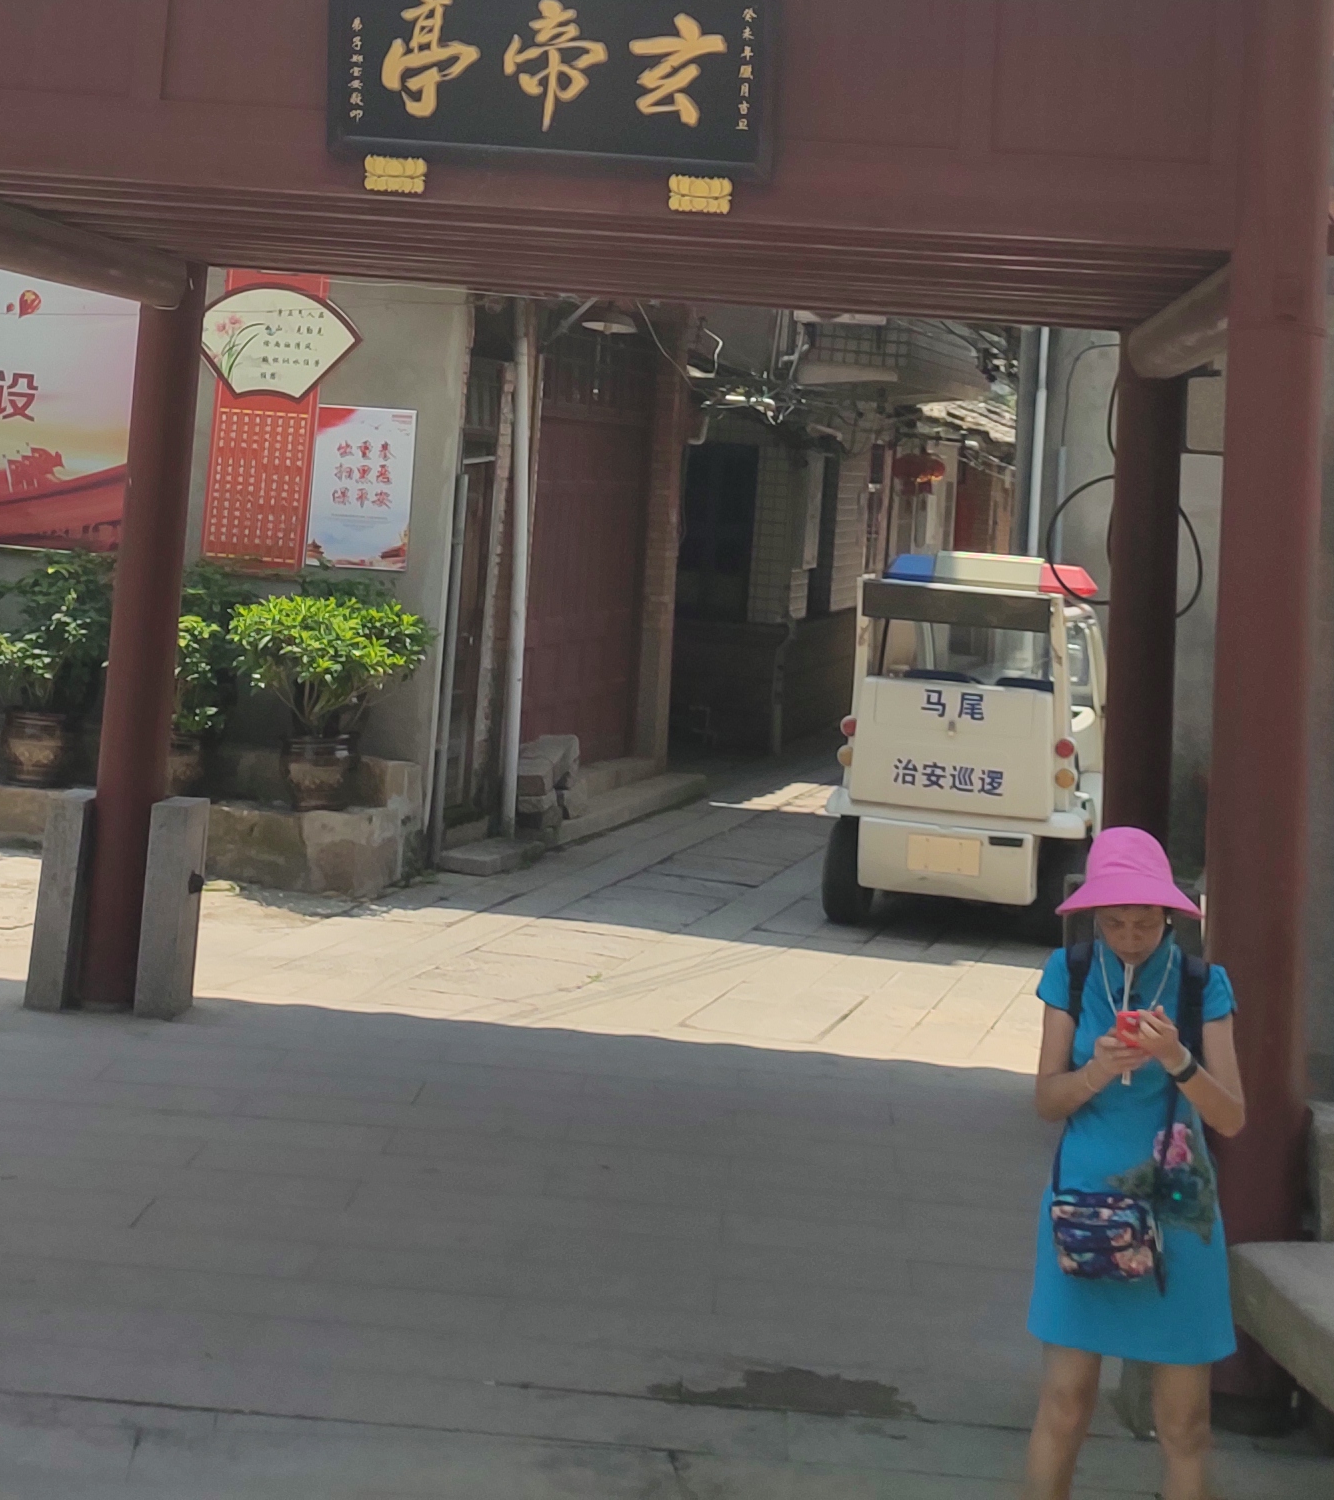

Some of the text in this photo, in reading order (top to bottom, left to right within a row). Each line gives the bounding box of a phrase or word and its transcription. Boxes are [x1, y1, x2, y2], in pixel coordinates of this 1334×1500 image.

[331, 487, 393, 510] 保平安
[921, 688, 985, 721] 马尾
[893, 758, 1005, 797] 治安巡逻
